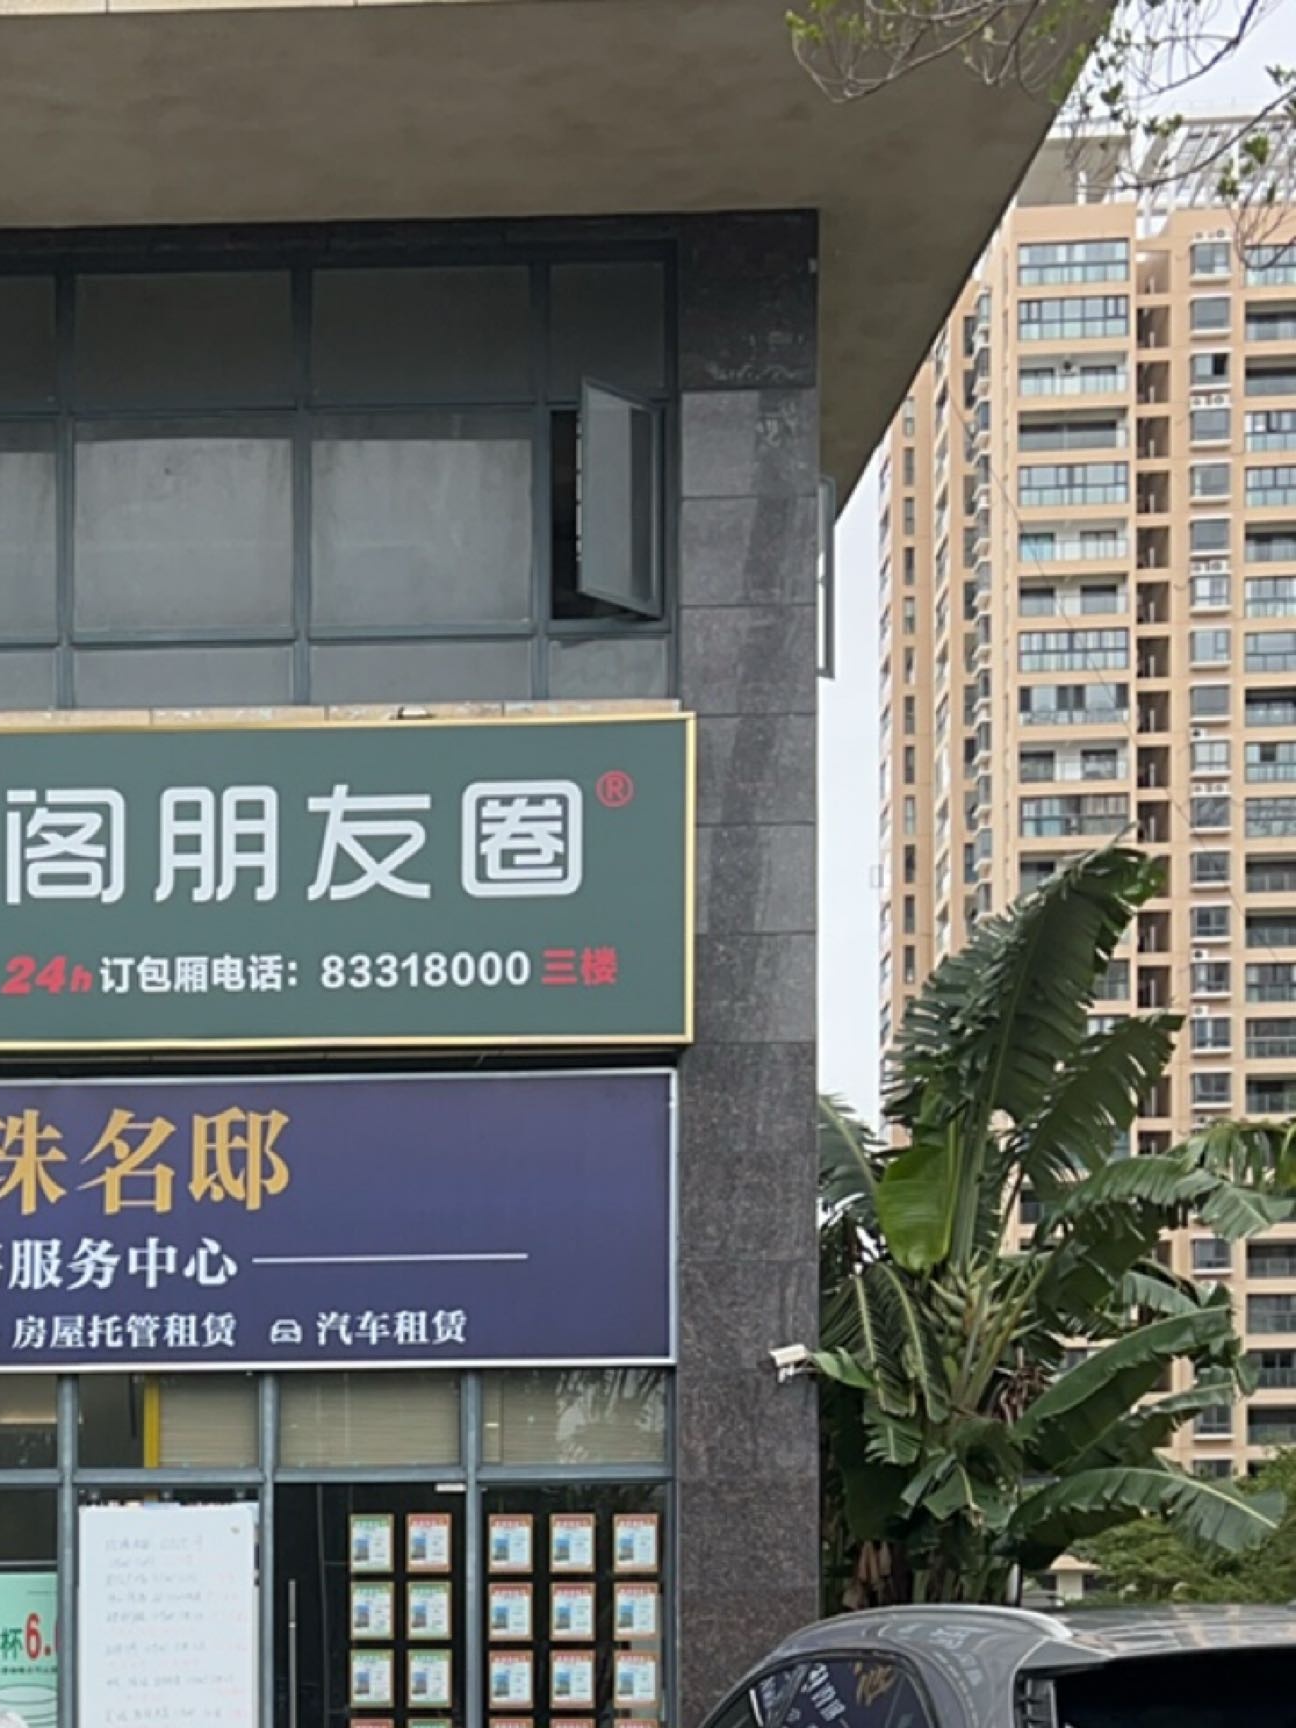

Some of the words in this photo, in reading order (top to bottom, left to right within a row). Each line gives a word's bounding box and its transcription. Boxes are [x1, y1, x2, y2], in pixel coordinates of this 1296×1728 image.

[0, 955, 94, 995] 24h
[321, 950, 532, 989] 83318000
[541, 945, 618, 986] 三楼
[11, 1312, 237, 1350] 房屋托管租赁
[316, 1309, 468, 1346] 汽车租赁
